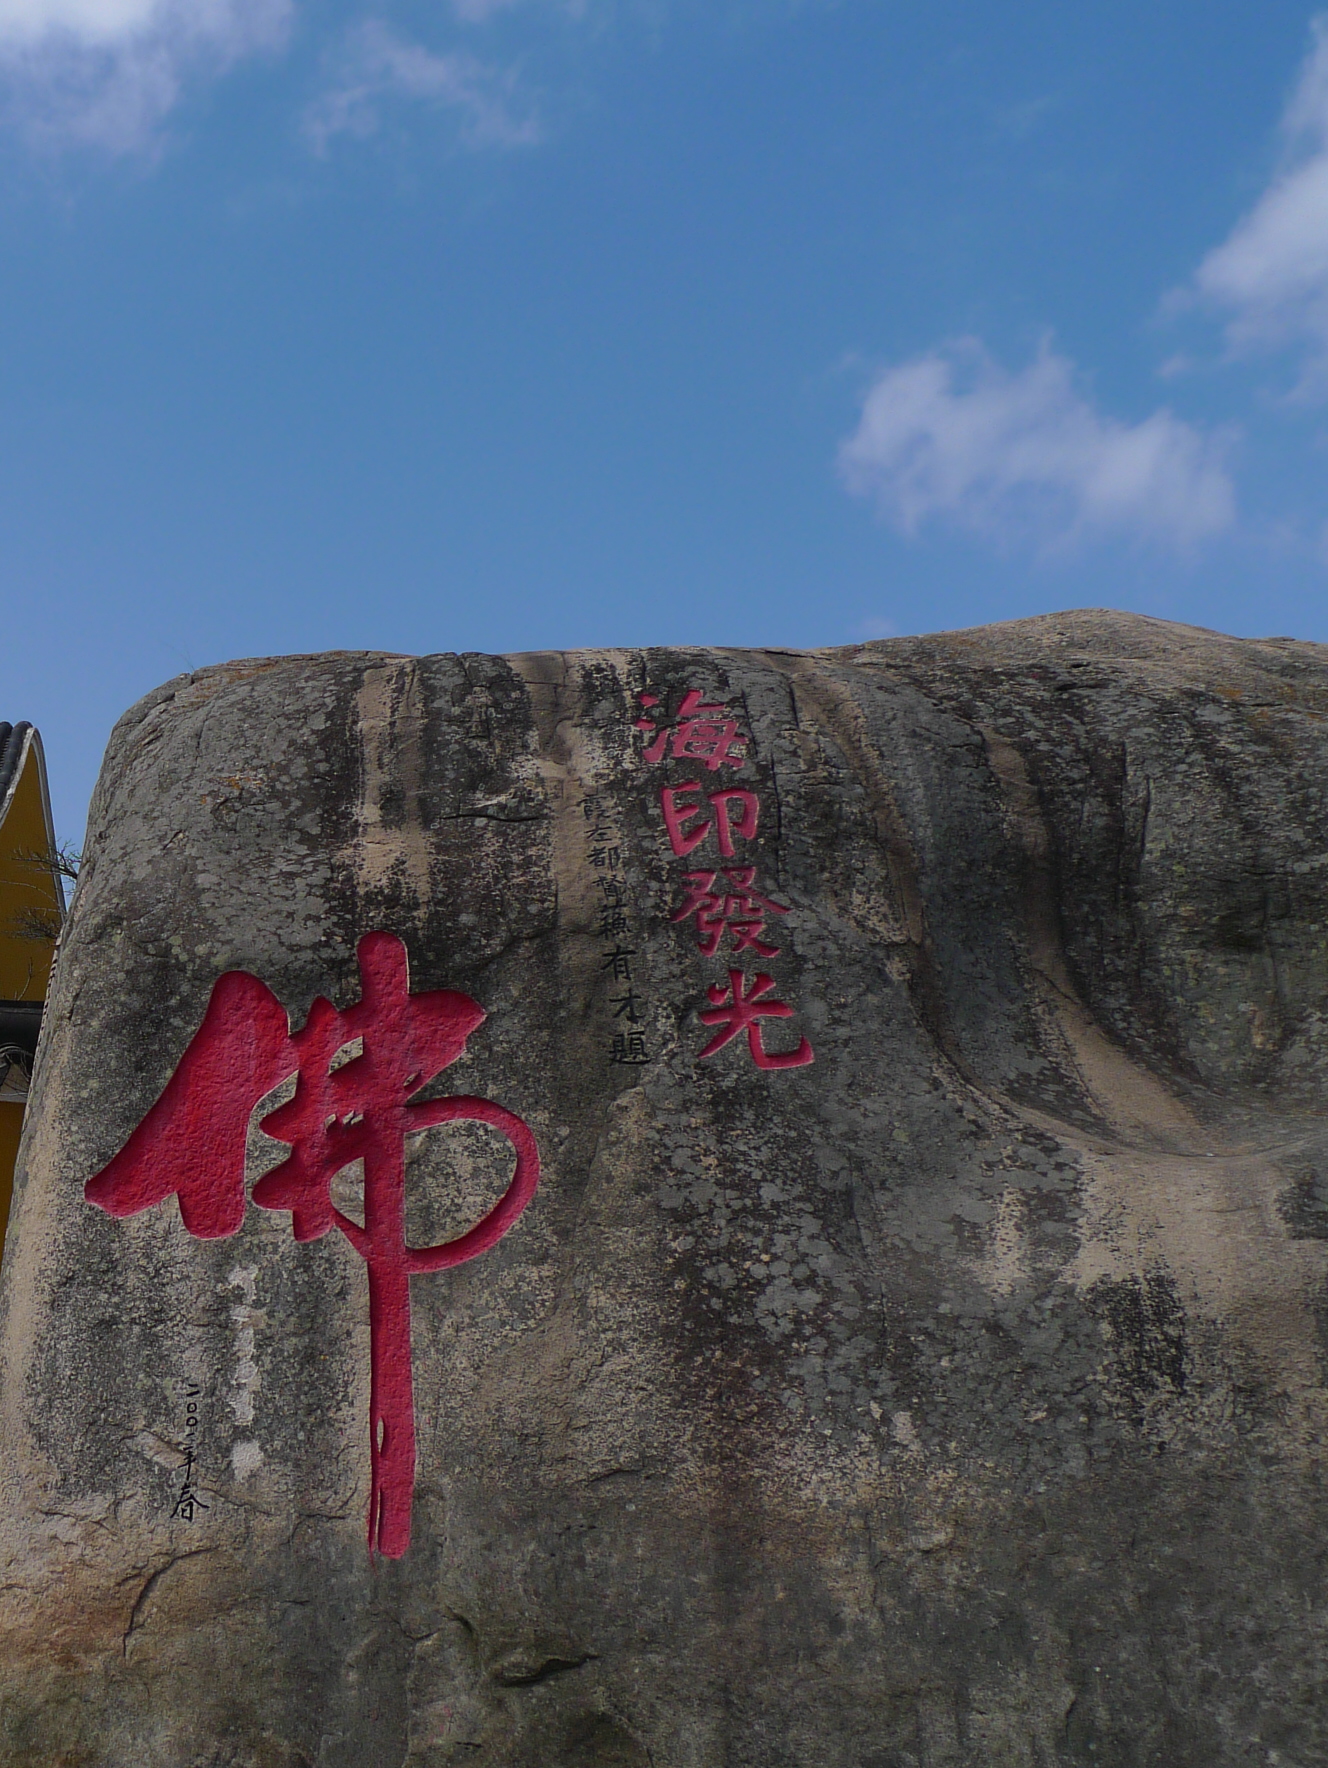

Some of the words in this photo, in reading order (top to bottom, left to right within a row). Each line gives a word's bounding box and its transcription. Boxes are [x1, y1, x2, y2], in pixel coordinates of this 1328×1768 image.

[634, 689, 815, 1070] 海印發光
[84, 930, 540, 1560] 佛
